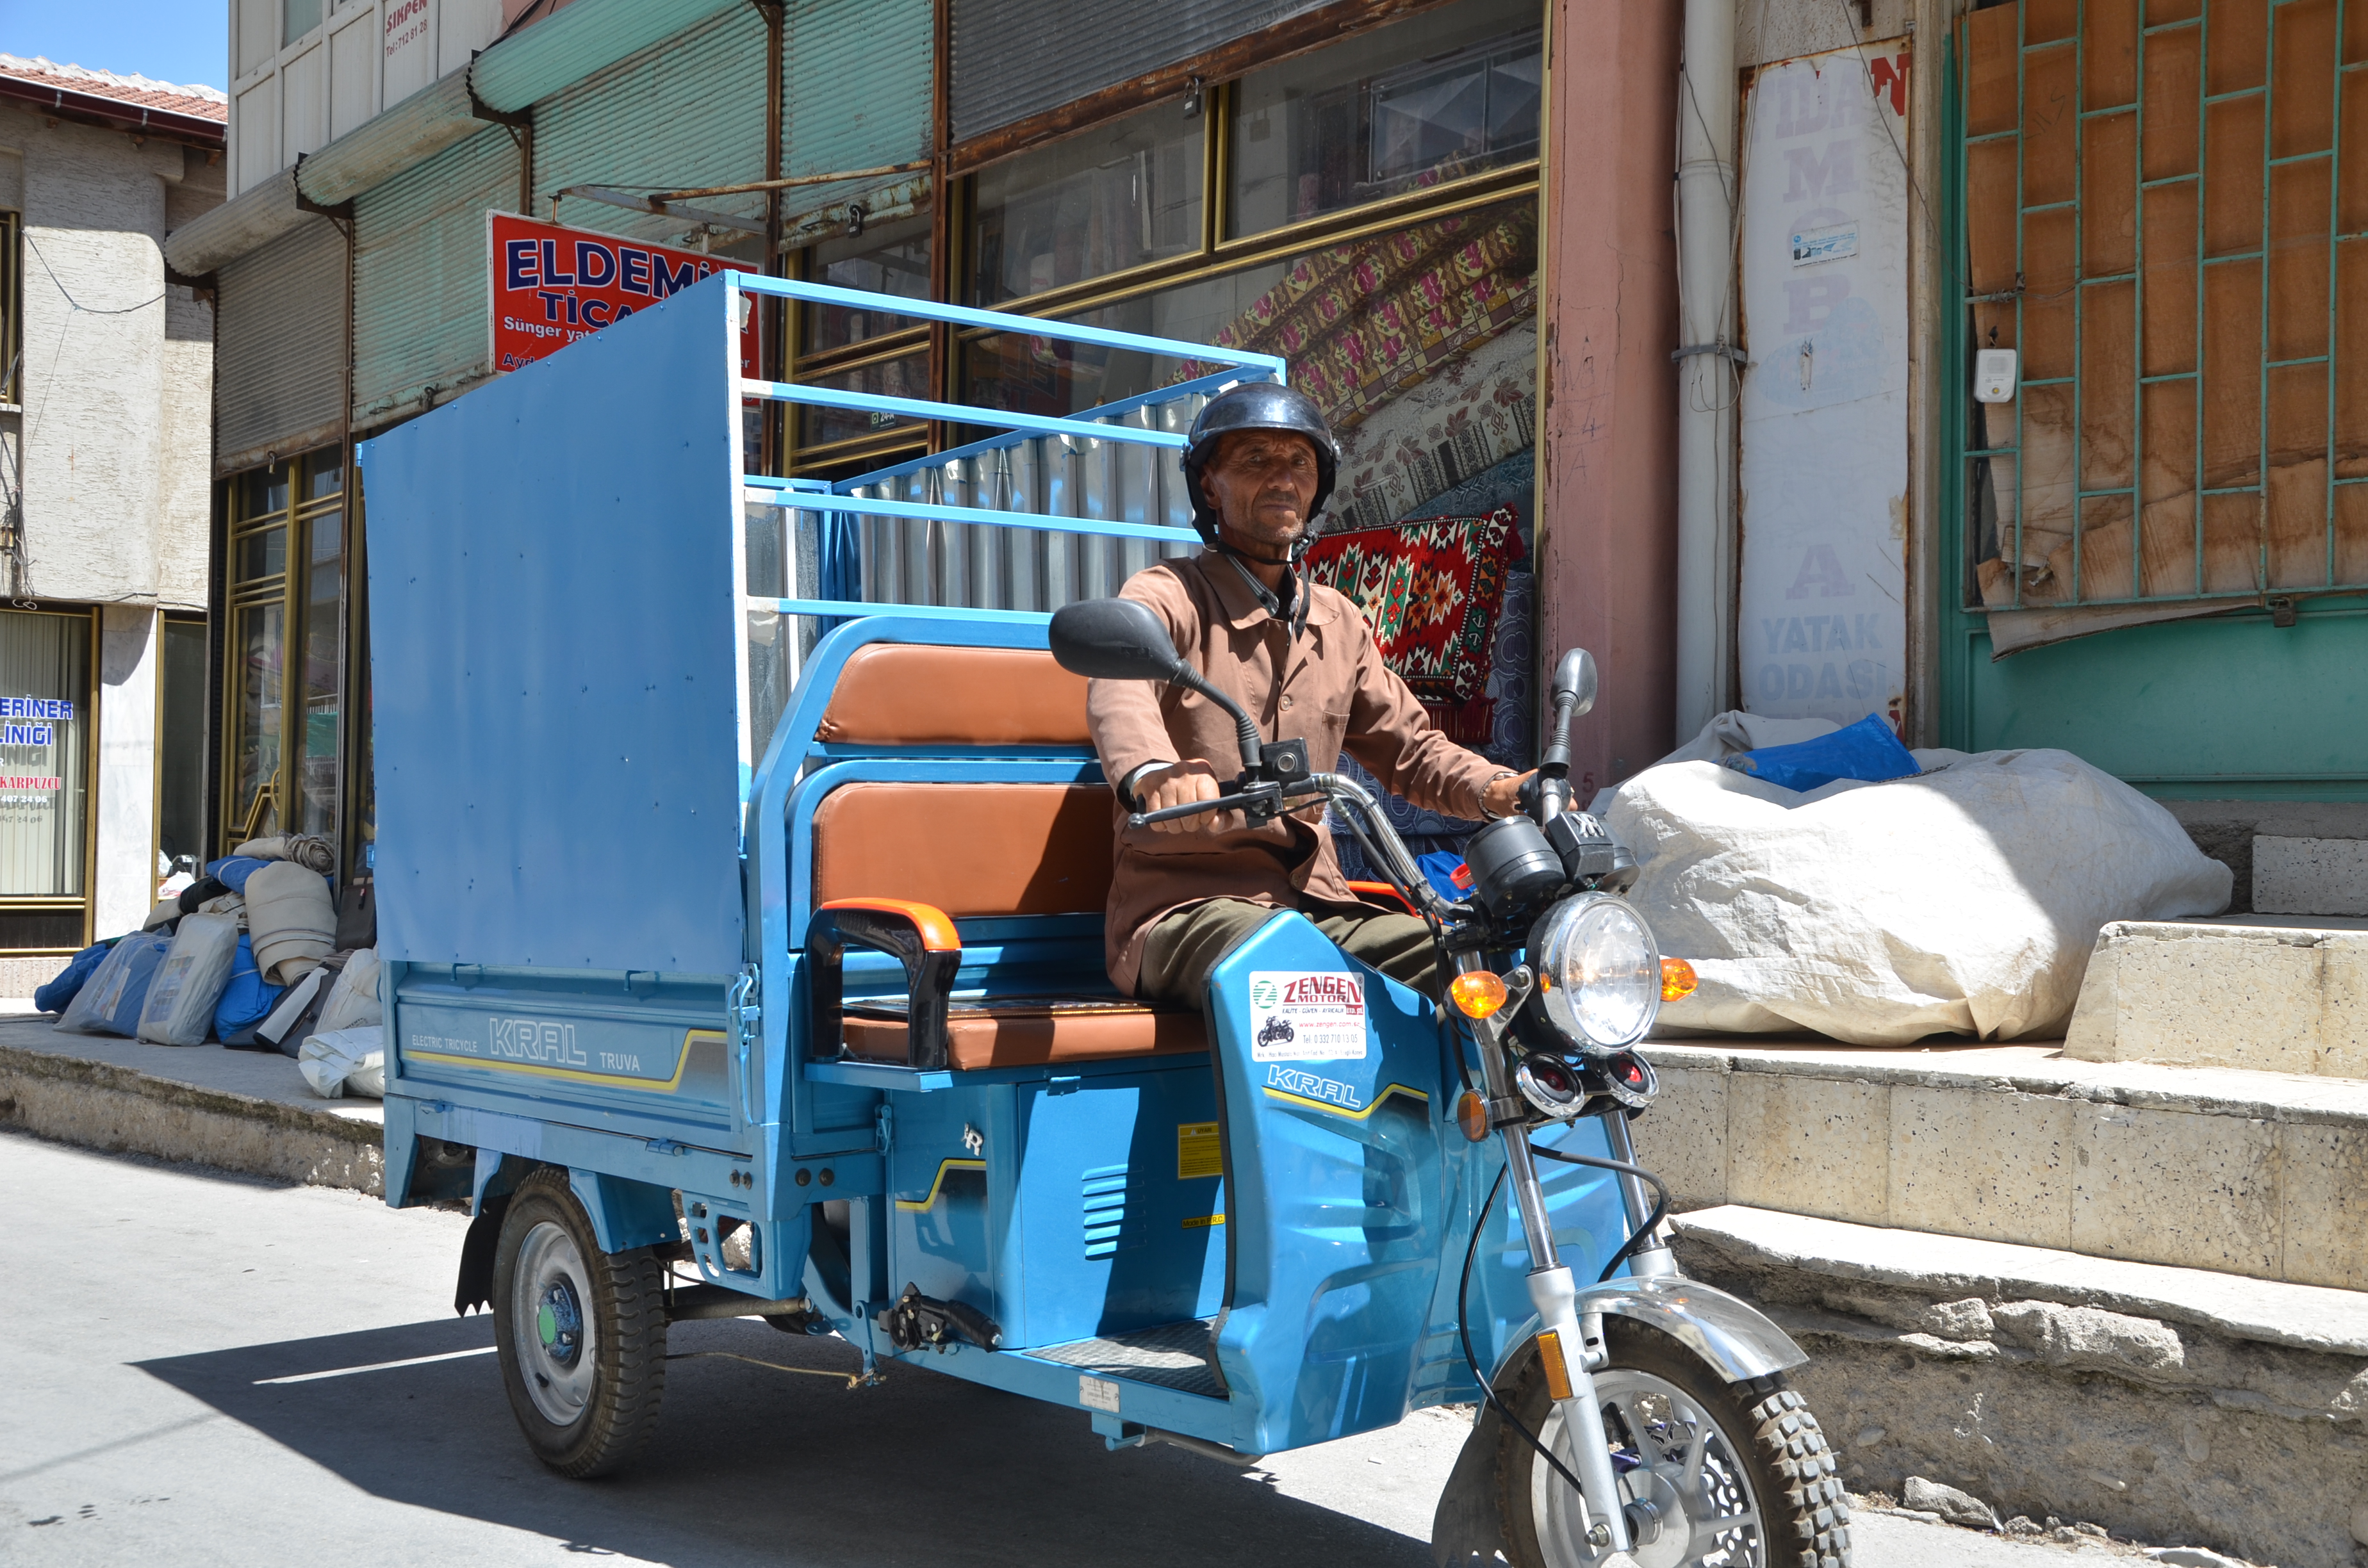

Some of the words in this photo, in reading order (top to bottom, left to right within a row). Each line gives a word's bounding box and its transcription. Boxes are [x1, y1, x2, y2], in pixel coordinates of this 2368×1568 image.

[411, 25, 417, 40] 81
[420, 19, 427, 33] 28
[504, 316, 562, 338] Sünger
[502, 353, 537, 370] Ayd
[1761, 612, 1883, 655] YATAK
[1758, 660, 1887, 701] ODASI
[1283, 976, 1361, 1003] ZENGEN
[412, 1034, 442, 1049] ELECTRIC
[445, 1038, 477, 1052] TRICYCLE
[489, 1017, 587, 1066] KRAL
[600, 1052, 640, 1072] TRUVA
[1314, 1034, 1318, 1043] 0
[1319, 1034, 1329, 1043] 332
[1331, 1034, 1340, 1043] 710
[1343, 1034, 1349, 1043] 13
[1351, 1034, 1358, 1043] 05
[1267, 1064, 1361, 1108] KRAL
[1183, 1220, 1199, 1228] Made
[1207, 1216, 1224, 1224] P.R.C.
